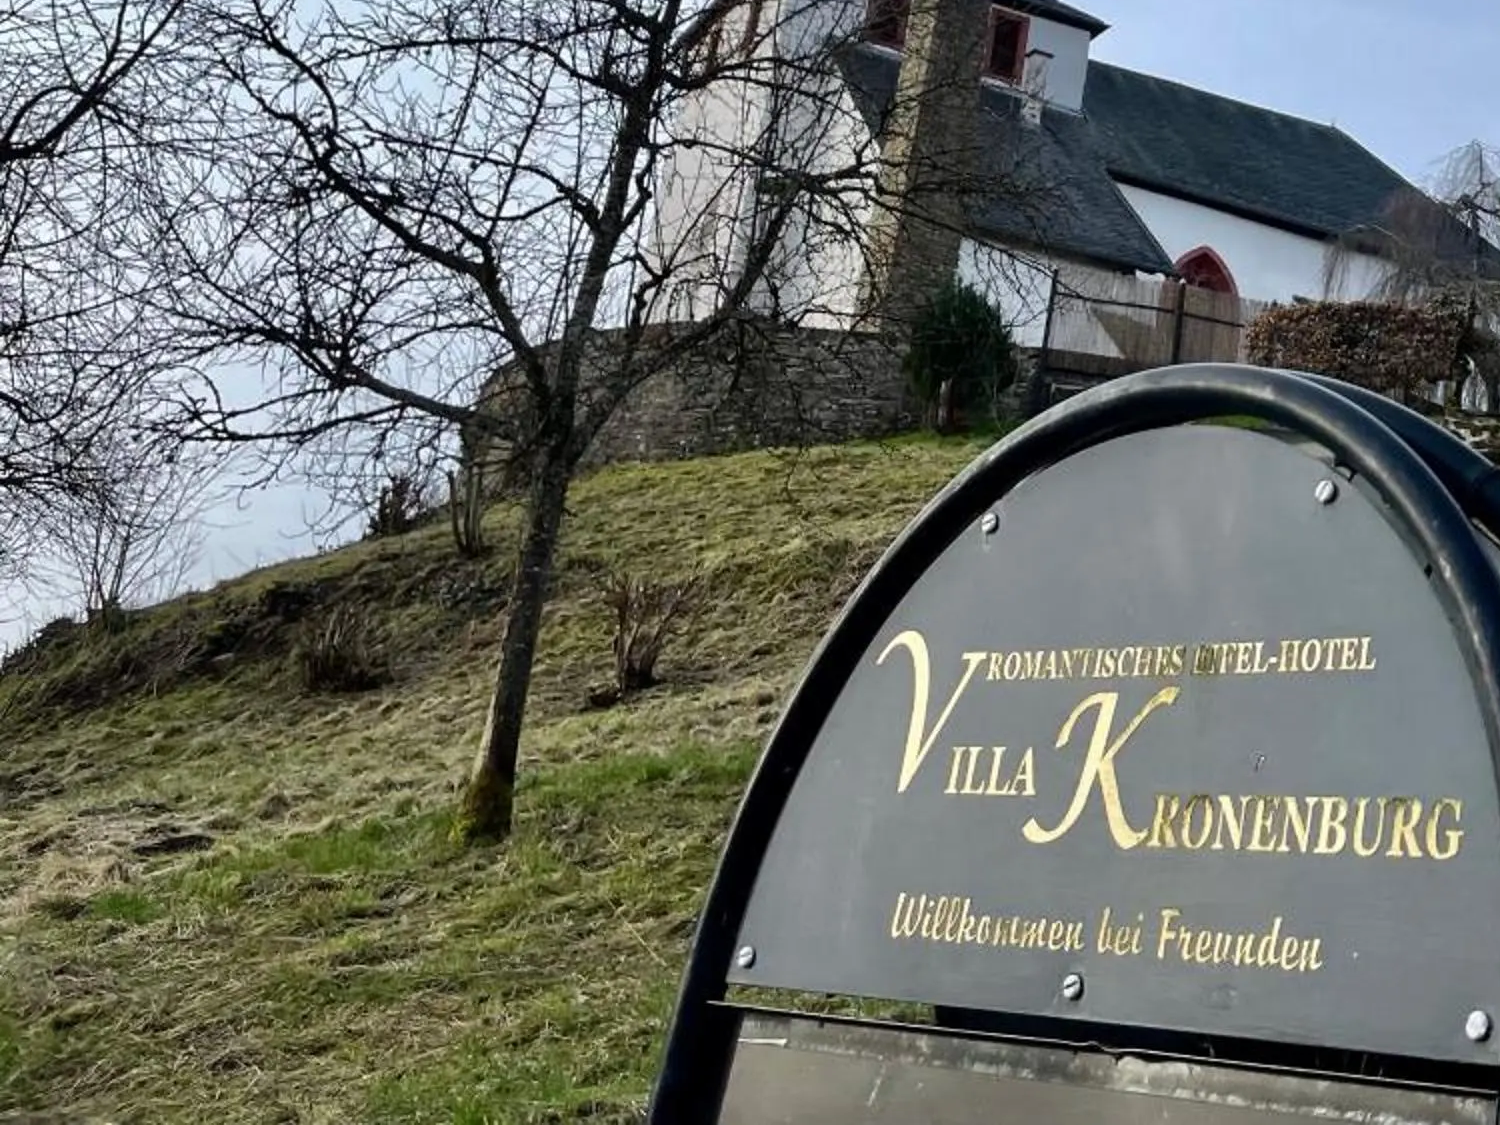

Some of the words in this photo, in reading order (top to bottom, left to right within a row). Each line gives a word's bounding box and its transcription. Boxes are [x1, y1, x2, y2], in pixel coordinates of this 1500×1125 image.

[985, 641, 1188, 682] ROMANTISCHES
[1190, 636, 1377, 676] EIFEL-HOTEL
[875, 629, 1037, 796] VILLA
[1021, 685, 1465, 861] KRONENBURG
[890, 891, 1086, 953] Willkommen
[1097, 906, 1144, 956] bei
[1156, 906, 1323, 972] Freunden
